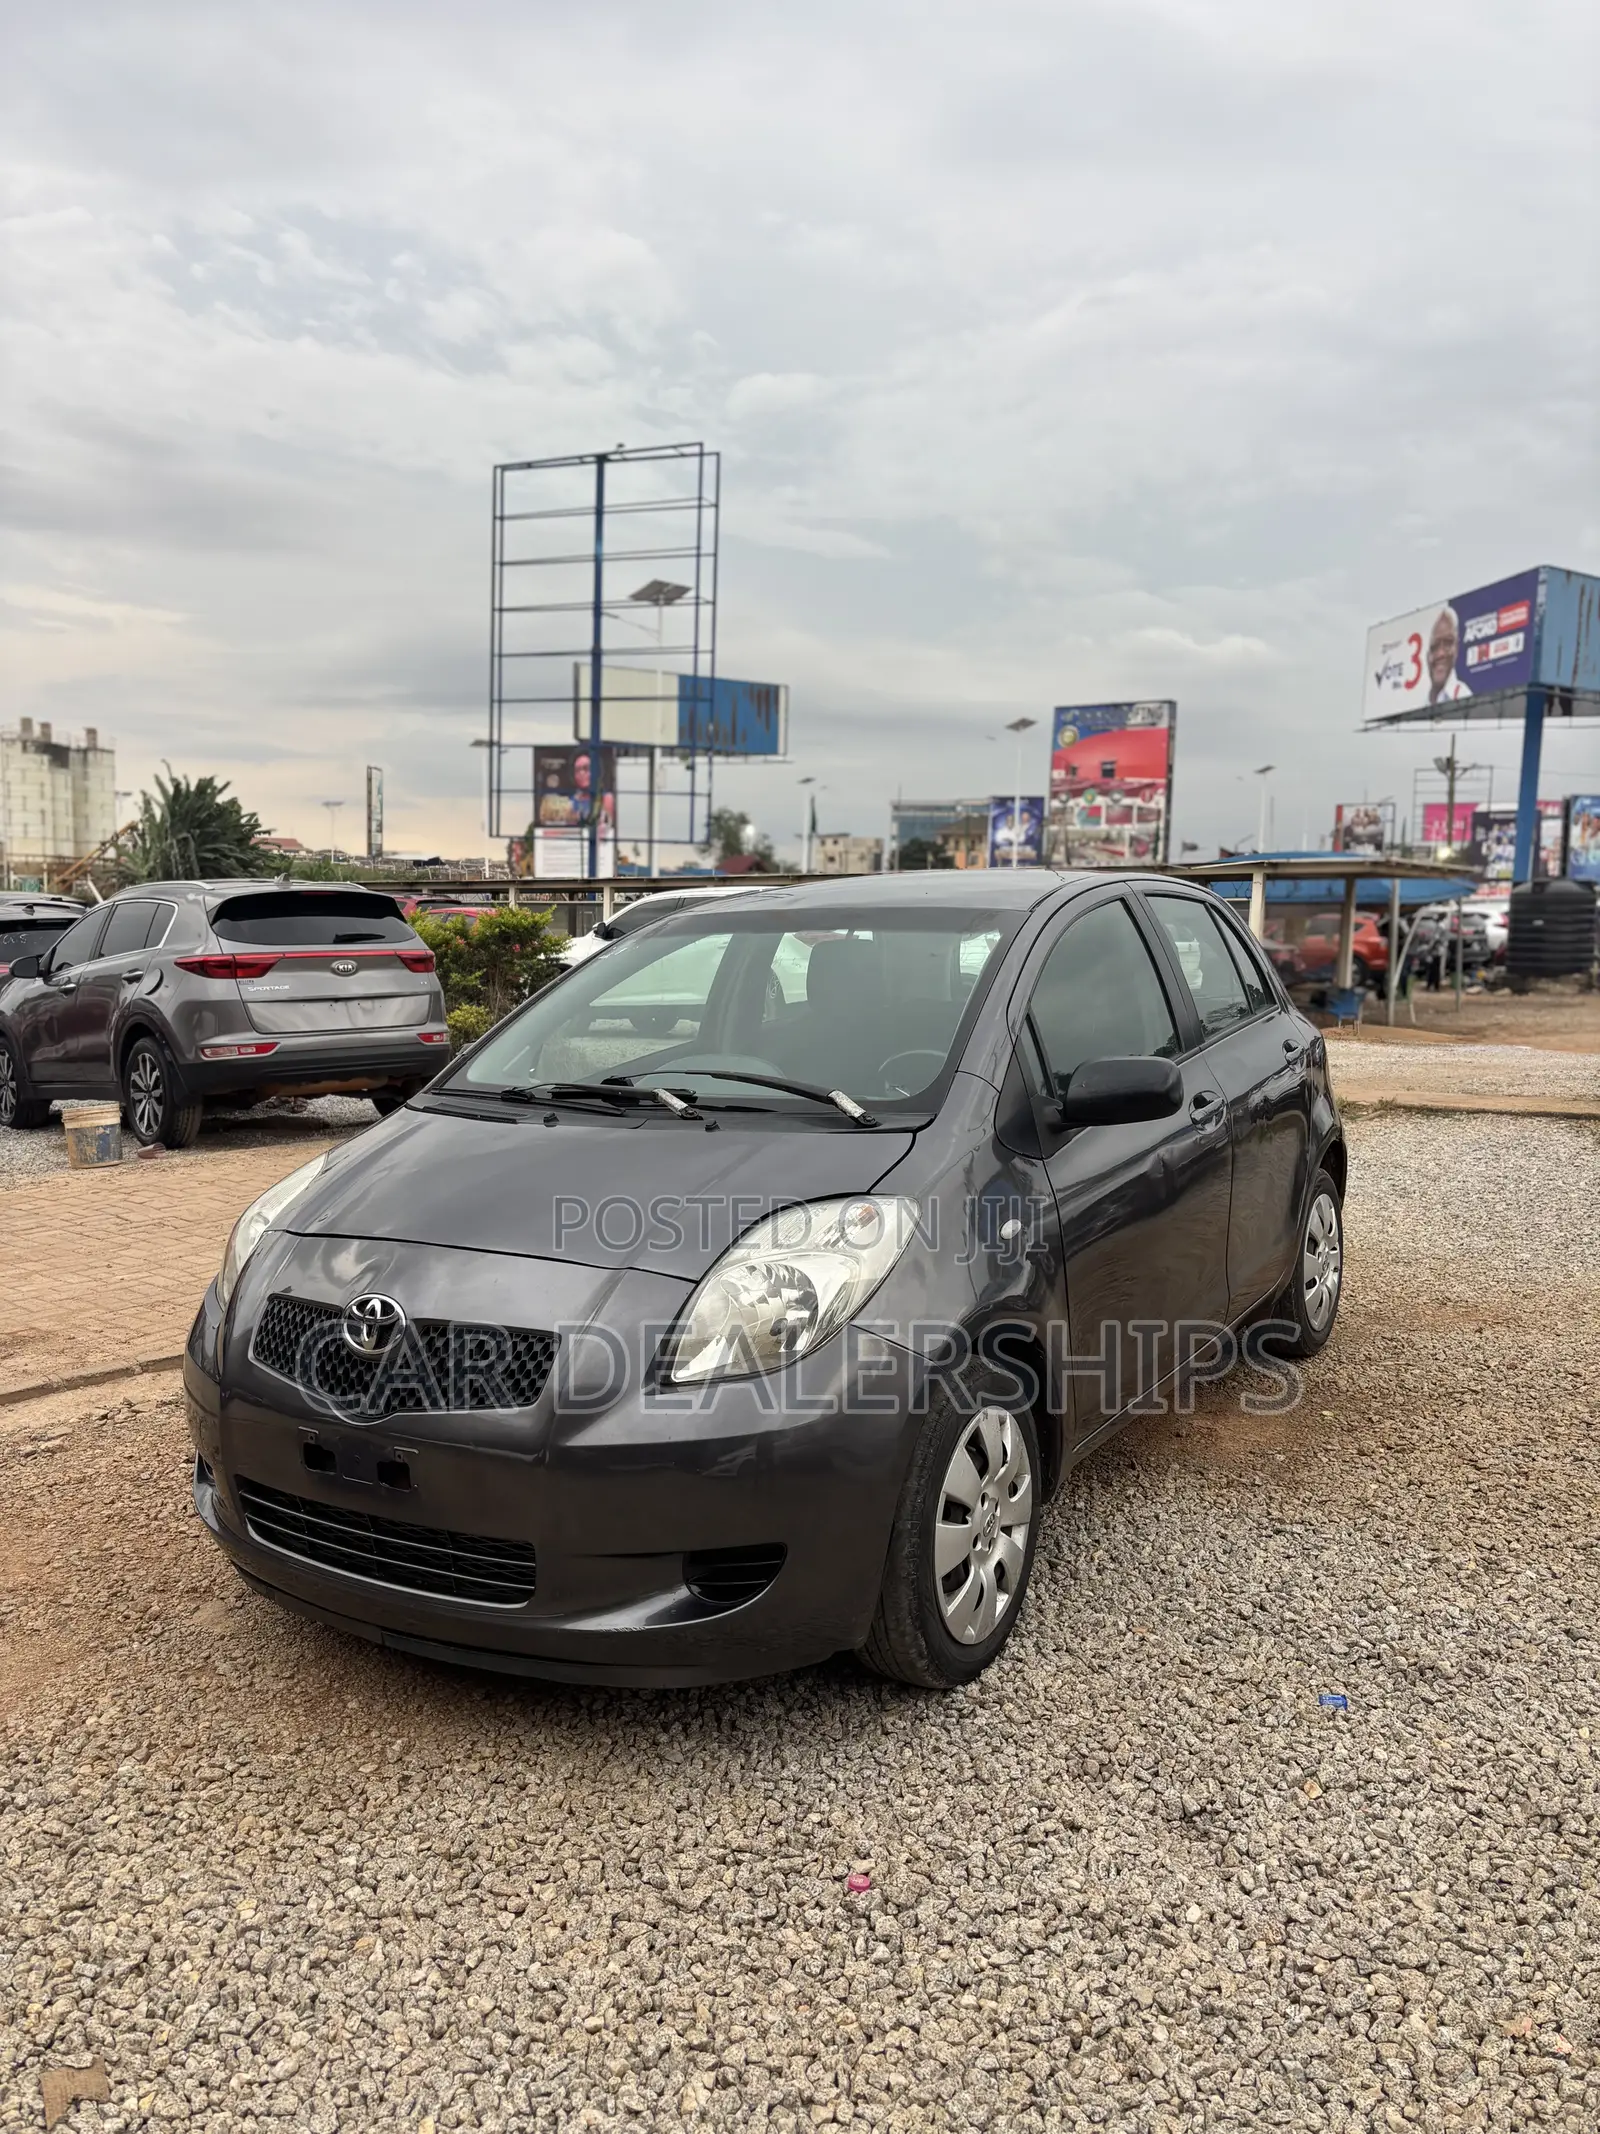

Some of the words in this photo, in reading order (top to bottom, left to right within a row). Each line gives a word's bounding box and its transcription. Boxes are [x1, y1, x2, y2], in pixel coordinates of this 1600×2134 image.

[1375, 656, 1404, 689] VOTE
[1404, 632, 1422, 690] 3
[247, 984, 290, 992] SPORTAGE
